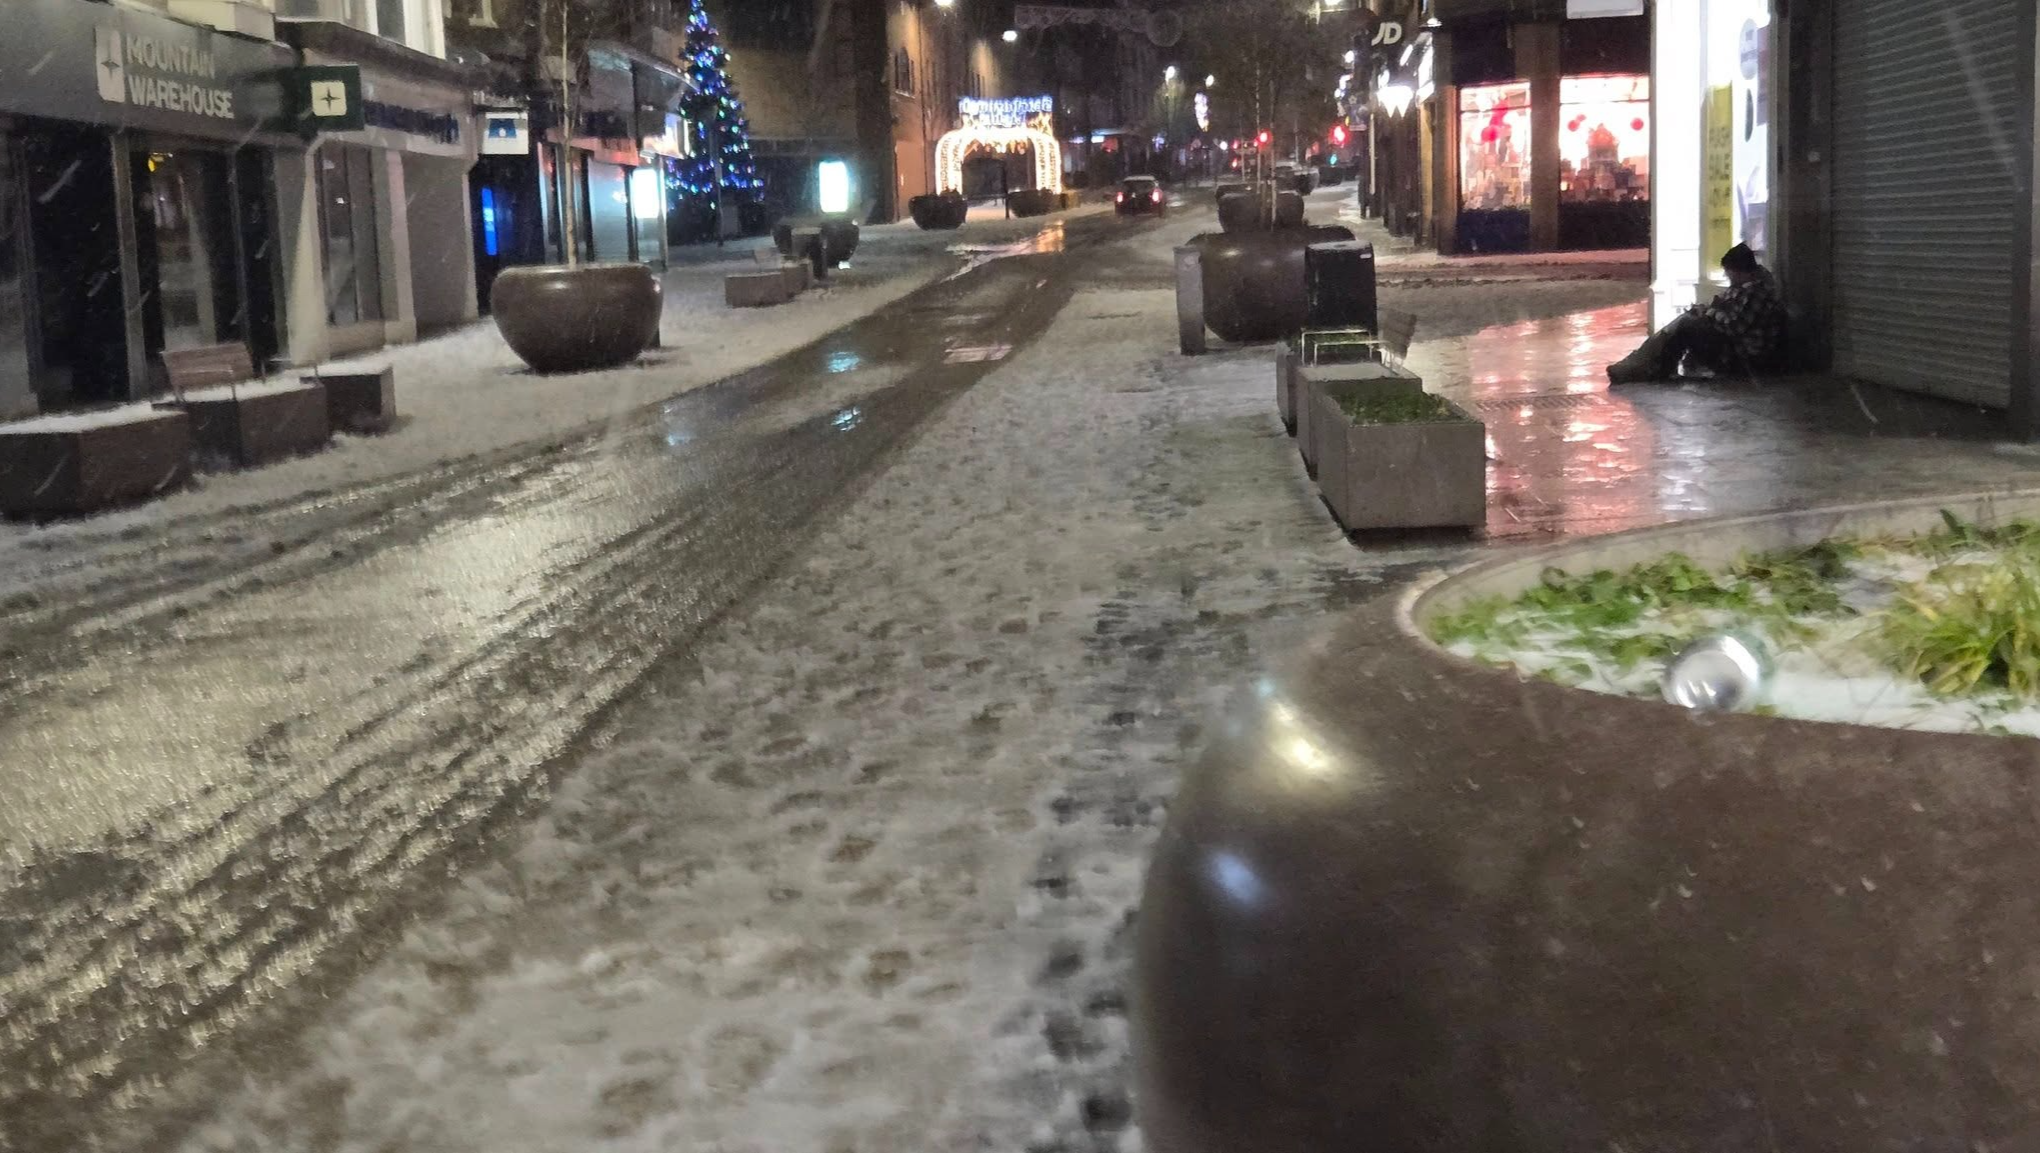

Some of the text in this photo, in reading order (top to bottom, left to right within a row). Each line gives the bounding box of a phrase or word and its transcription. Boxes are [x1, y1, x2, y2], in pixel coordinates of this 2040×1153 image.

[126, 33, 215, 79] MOUNTAIN
[1371, 22, 1402, 46] JD
[128, 74, 235, 119] WAREHOUSE
